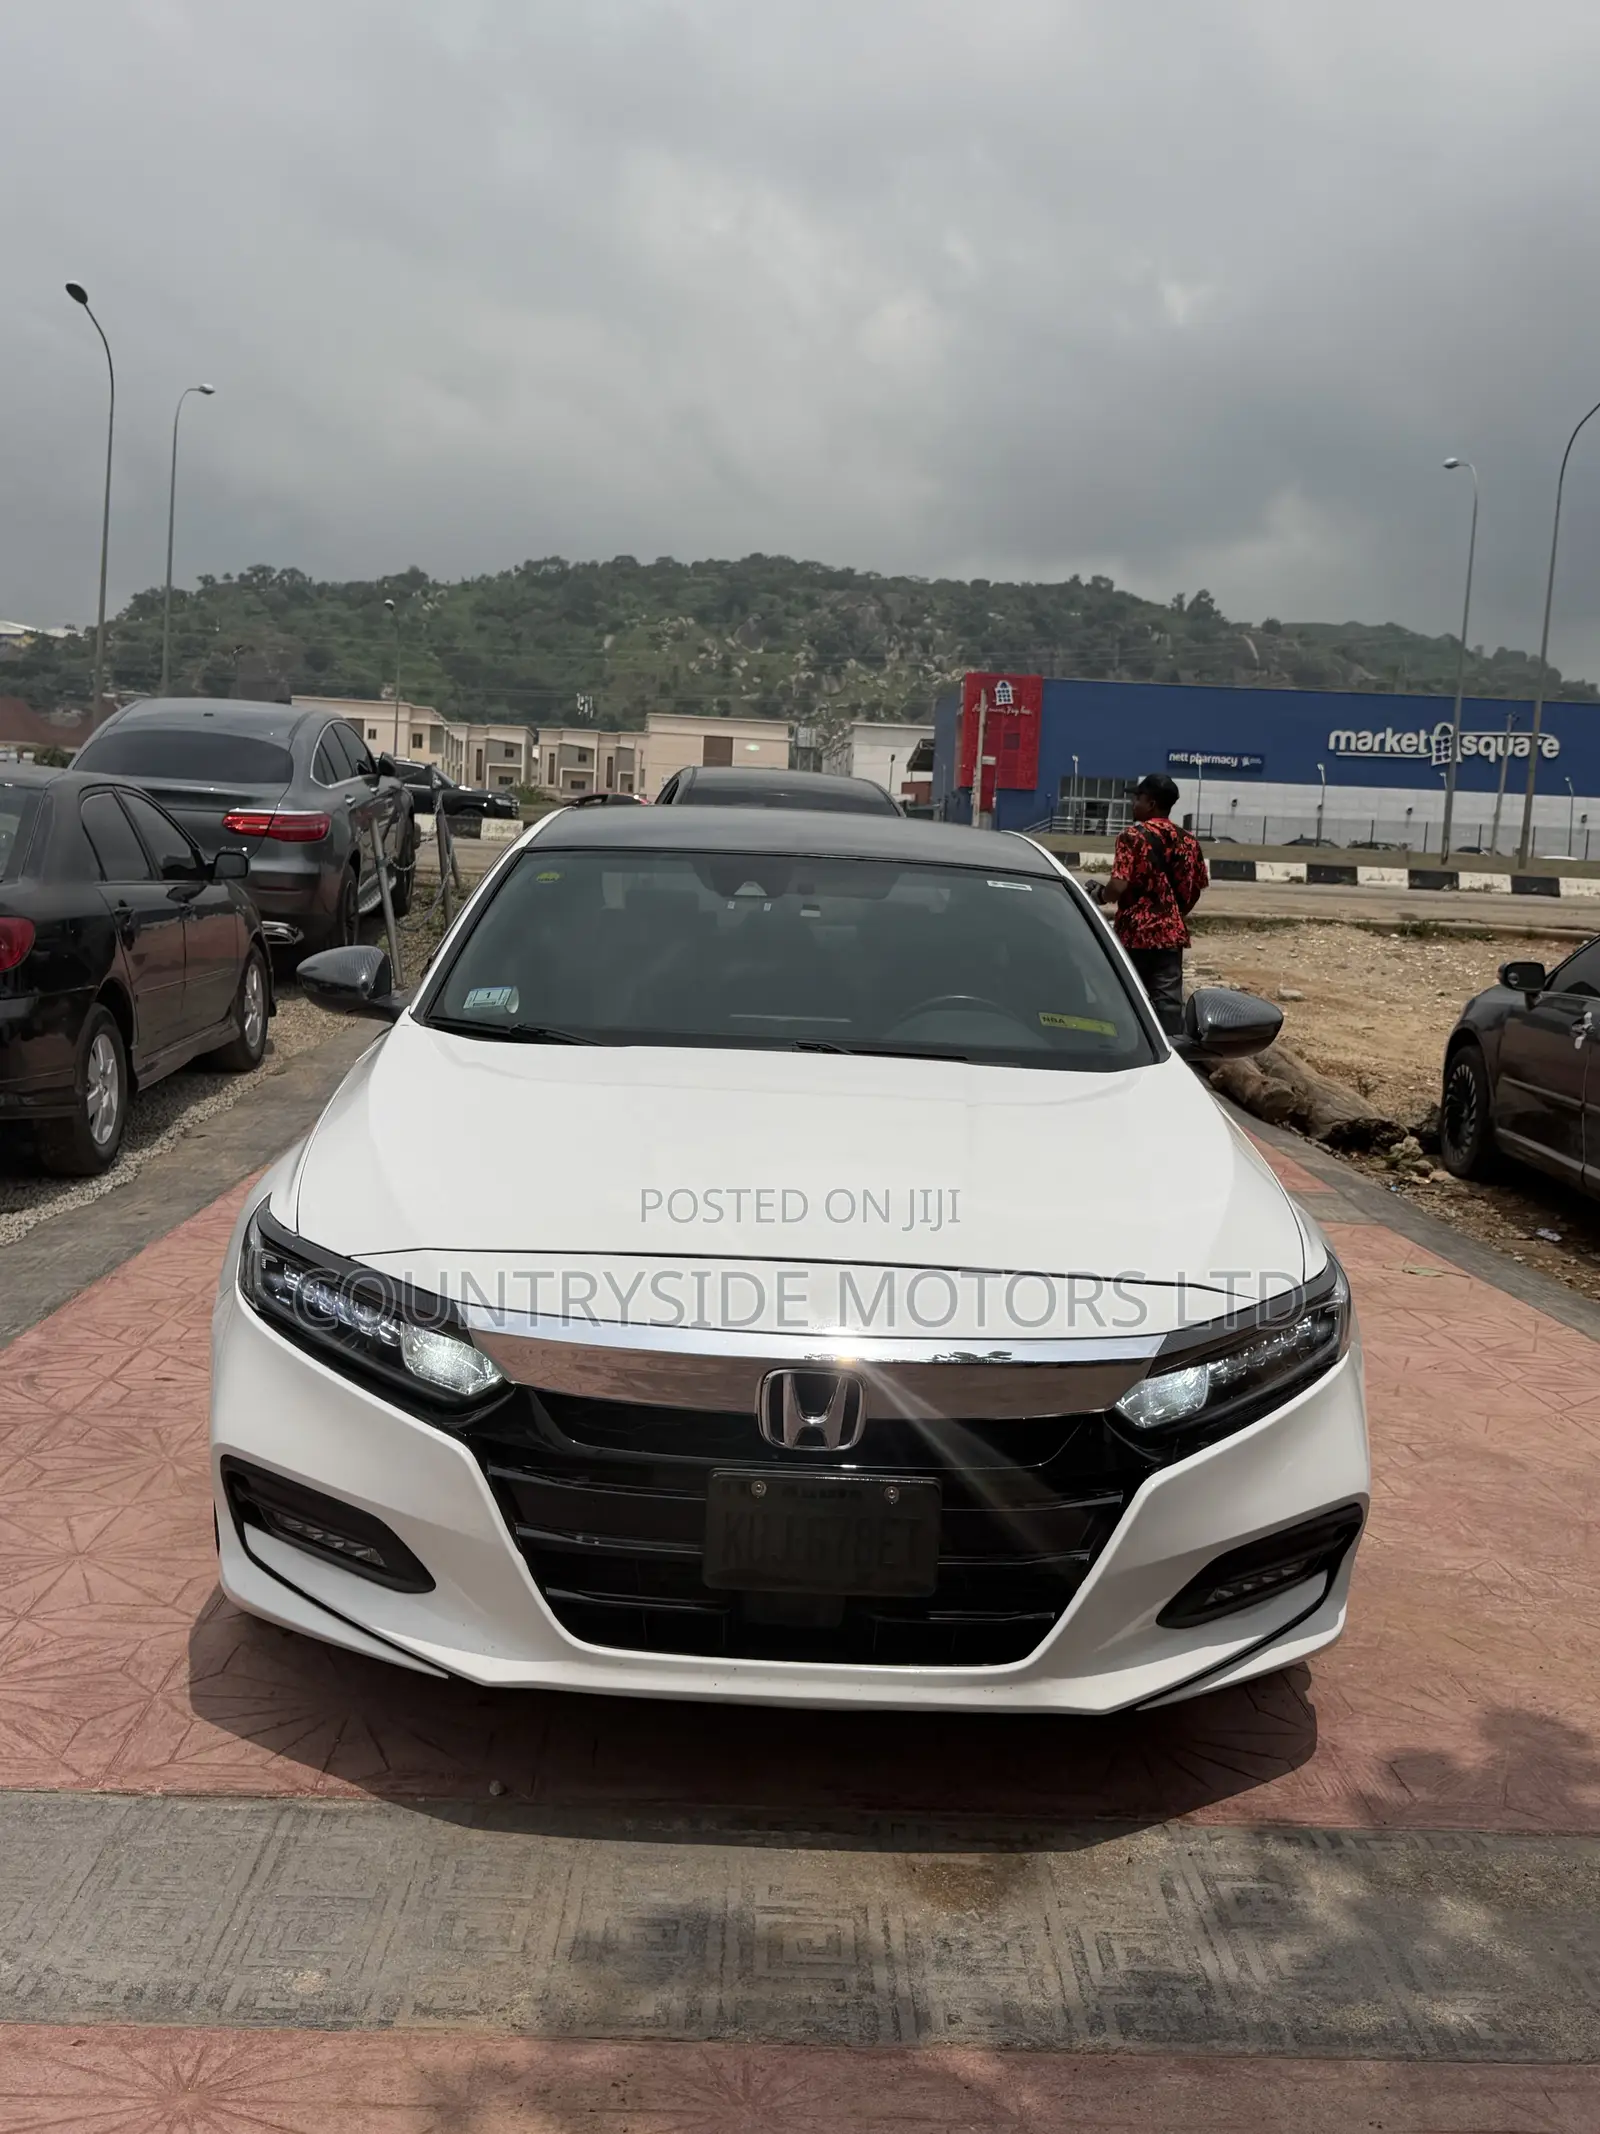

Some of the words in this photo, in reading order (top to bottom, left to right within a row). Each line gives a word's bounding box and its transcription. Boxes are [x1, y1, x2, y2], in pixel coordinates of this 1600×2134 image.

[1328, 727, 1428, 754] market
[1461, 736, 1560, 763] squae
[1169, 753, 1188, 762] nett
[1189, 753, 1238, 767] pharmacy
